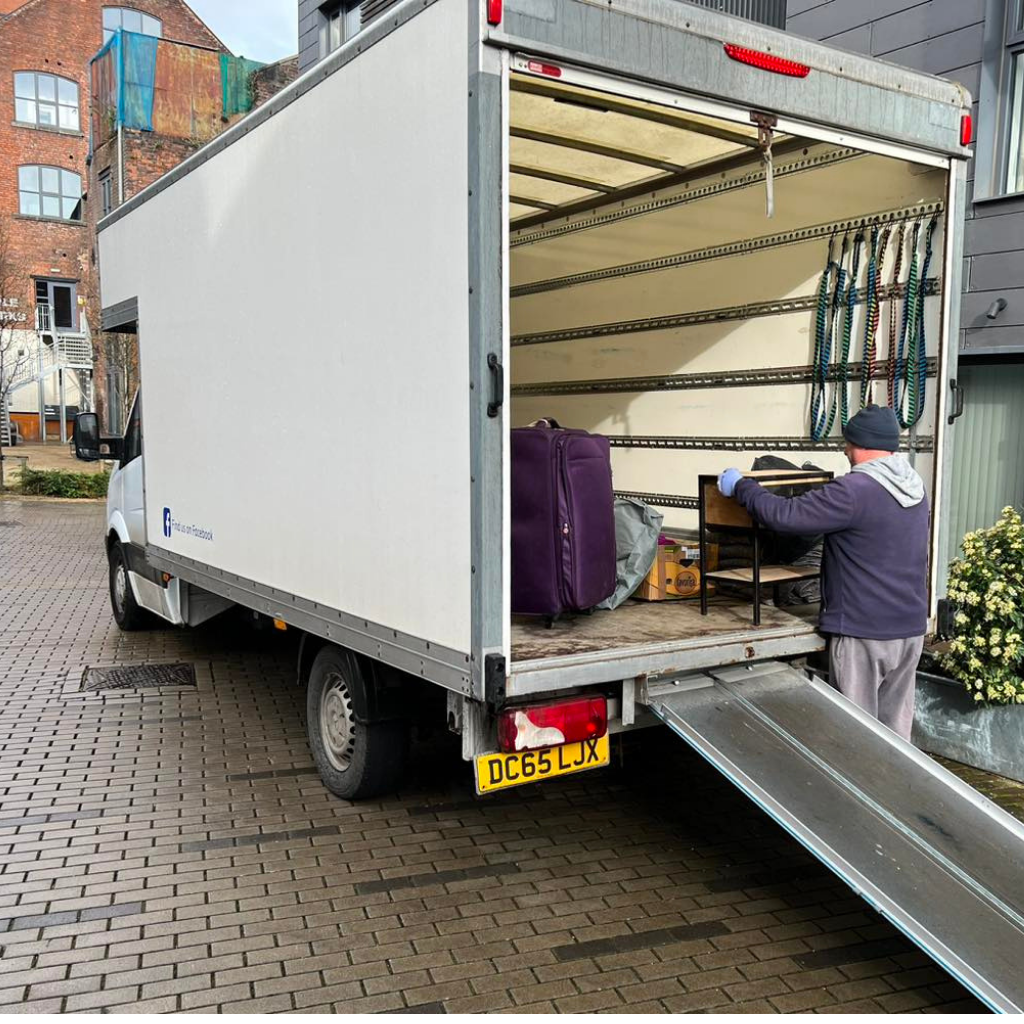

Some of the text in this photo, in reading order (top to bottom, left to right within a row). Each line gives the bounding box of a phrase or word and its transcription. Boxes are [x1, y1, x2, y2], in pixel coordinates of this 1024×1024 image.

[192, 524, 213, 541] Facebook
[488, 738, 600, 785] DC65 LJX
